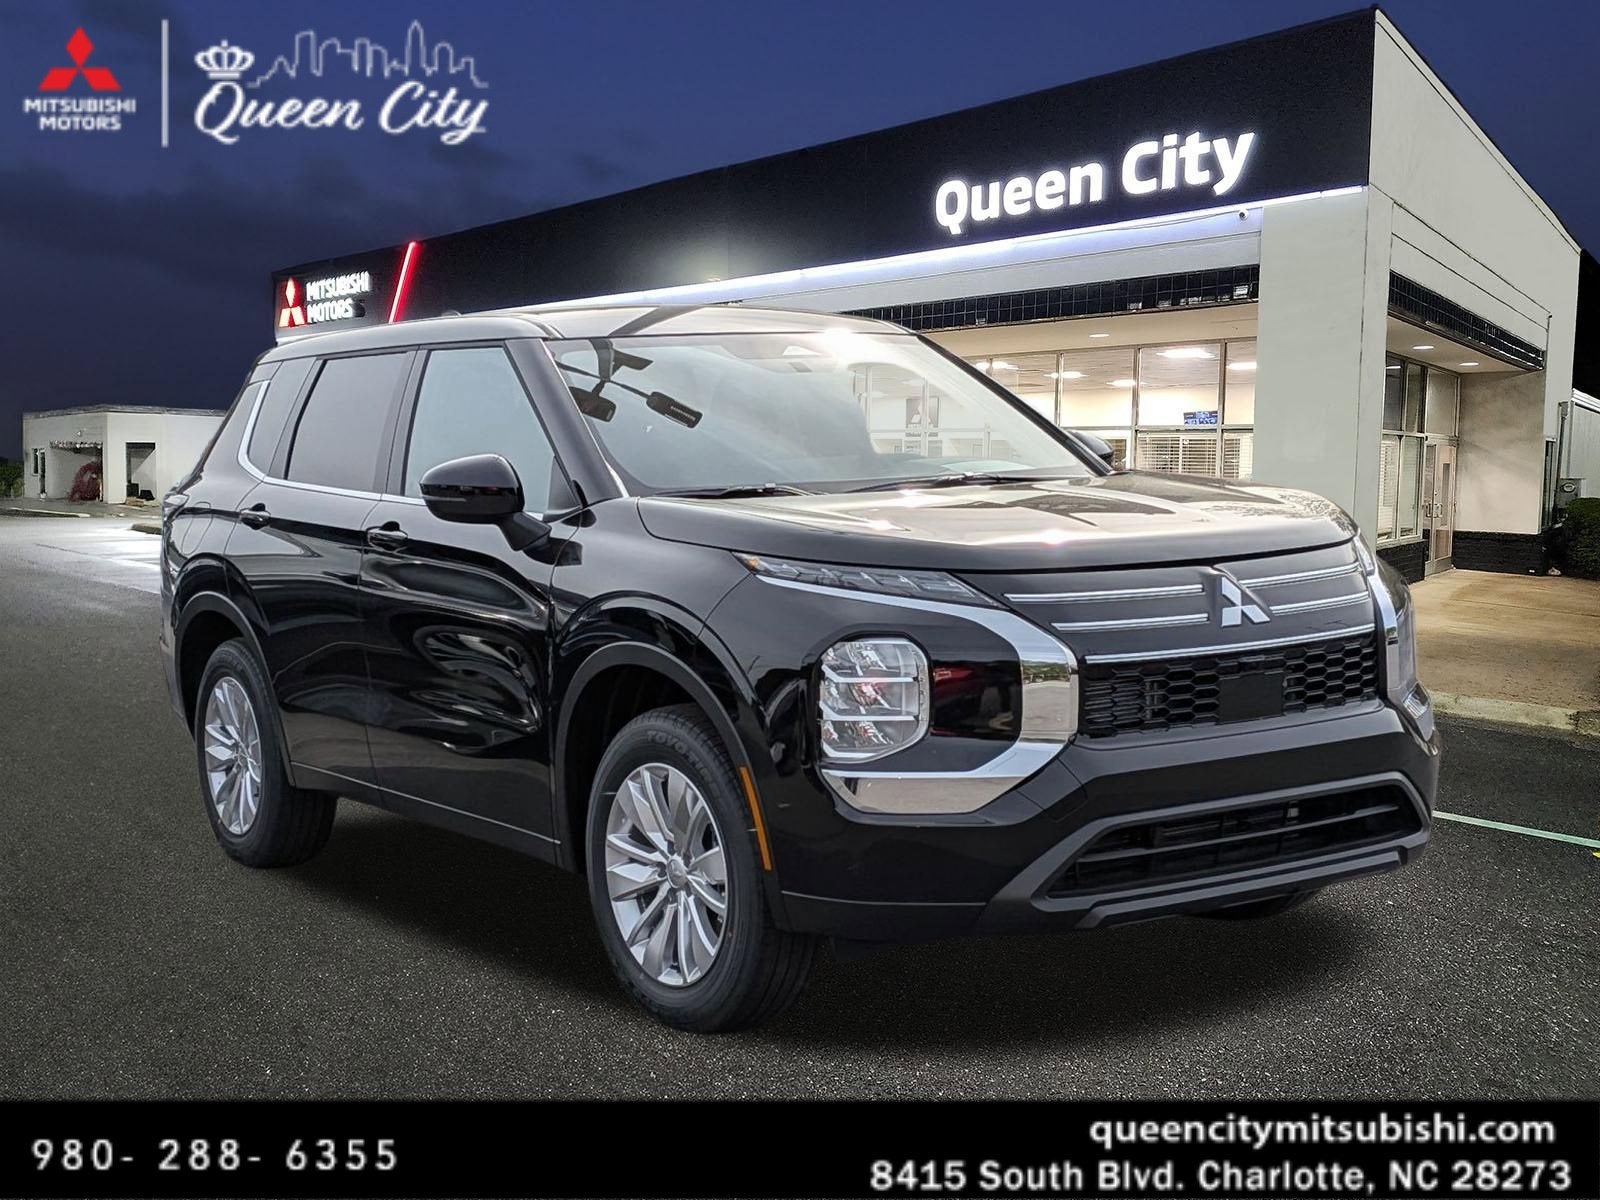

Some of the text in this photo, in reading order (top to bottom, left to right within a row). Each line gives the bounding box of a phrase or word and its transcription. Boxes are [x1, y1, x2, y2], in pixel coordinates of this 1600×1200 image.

[935, 131, 1255, 235] Queen City
[306, 270, 371, 301] MITSUBISHI
[306, 298, 355, 324] MOTORS
